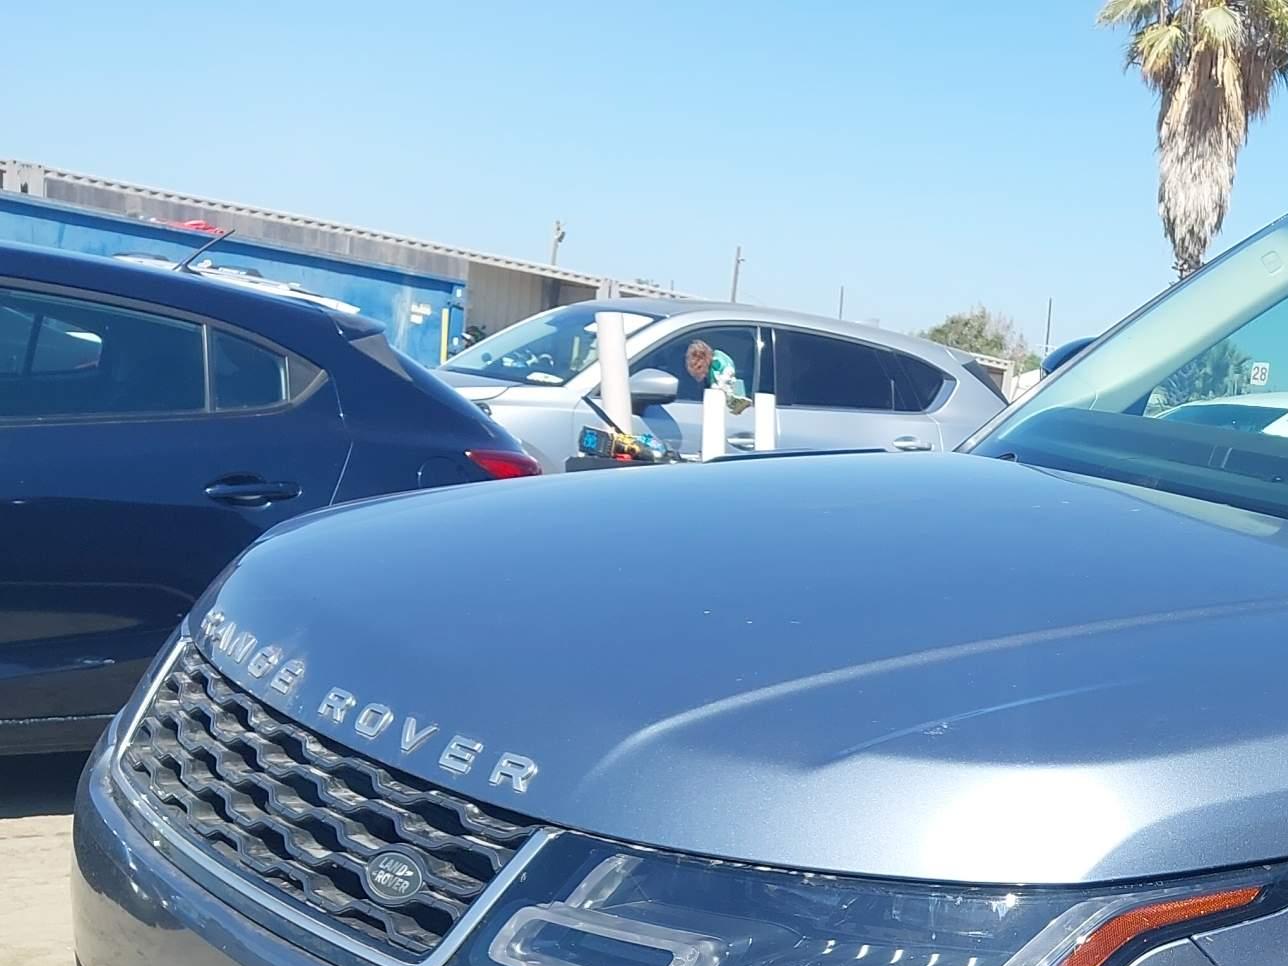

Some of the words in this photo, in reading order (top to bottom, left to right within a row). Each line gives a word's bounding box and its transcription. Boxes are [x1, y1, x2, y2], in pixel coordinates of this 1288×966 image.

[1252, 366, 1268, 382] 28
[317, 686, 539, 793] ROVER
[378, 856, 409, 876] LAND
[374, 869, 410, 894] ROVER
